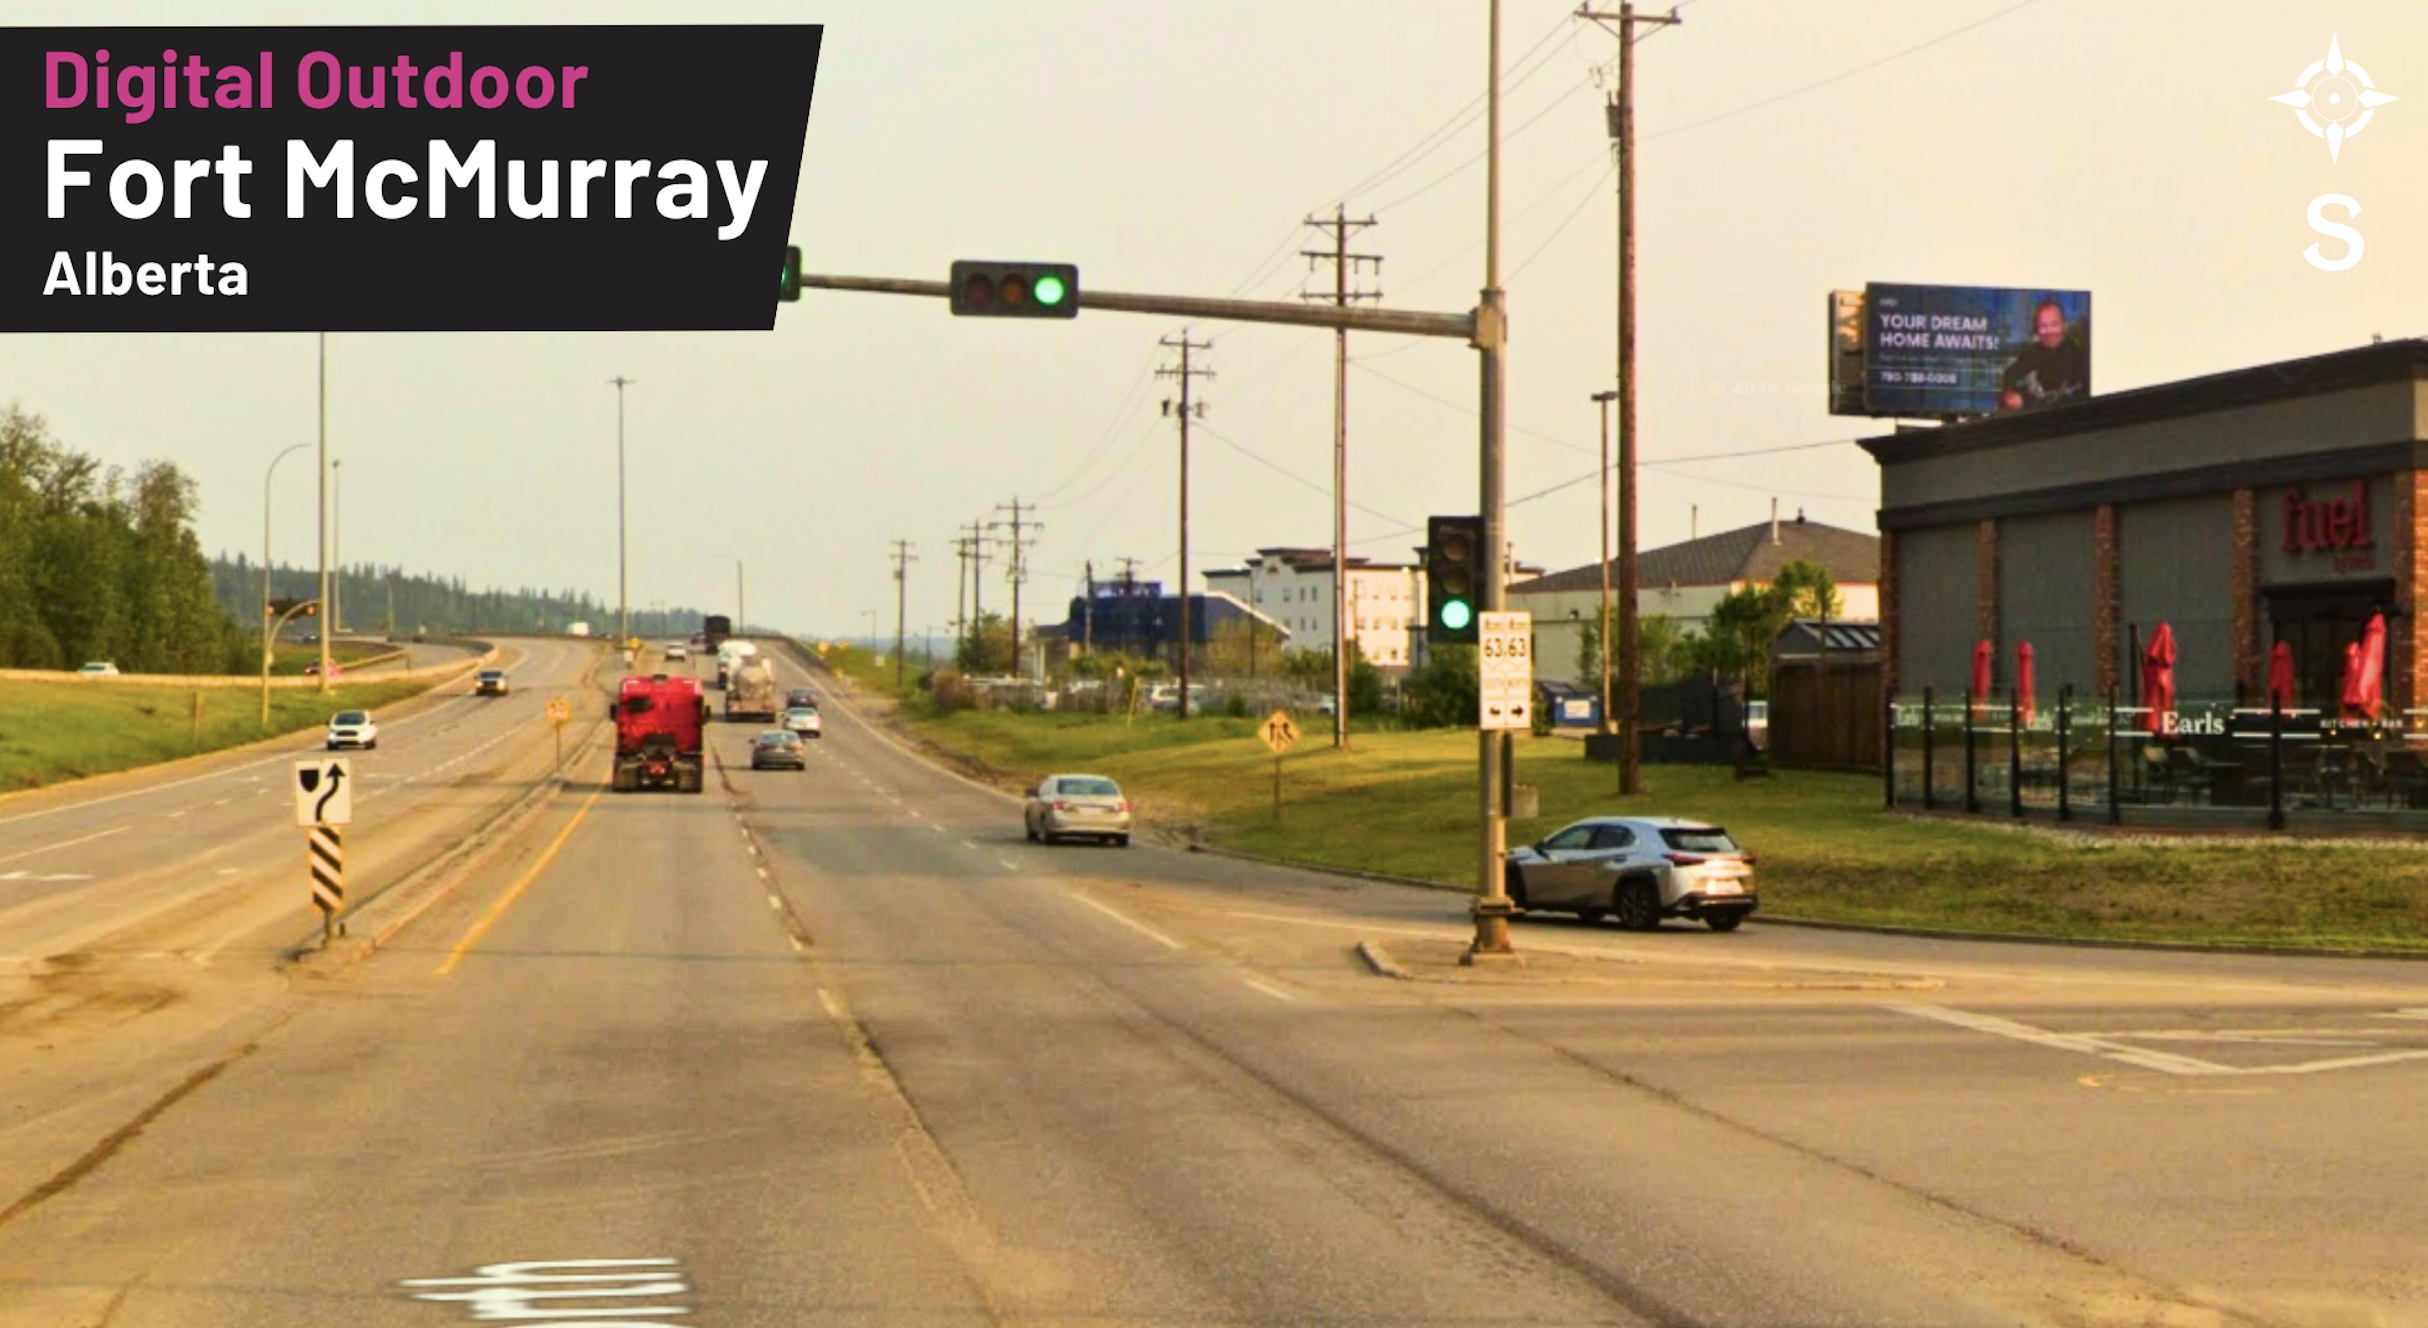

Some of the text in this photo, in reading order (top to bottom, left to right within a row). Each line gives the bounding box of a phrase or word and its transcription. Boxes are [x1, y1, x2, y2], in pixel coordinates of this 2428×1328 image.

[1880, 314, 1987, 332] YOUR DREAM
[1880, 332, 1999, 350] HOME AWAITS!
[2281, 480, 2370, 551] fuel
[1484, 637, 1503, 659] 63
[1508, 637, 1527, 659] 63
[2161, 711, 2225, 735] Earls
